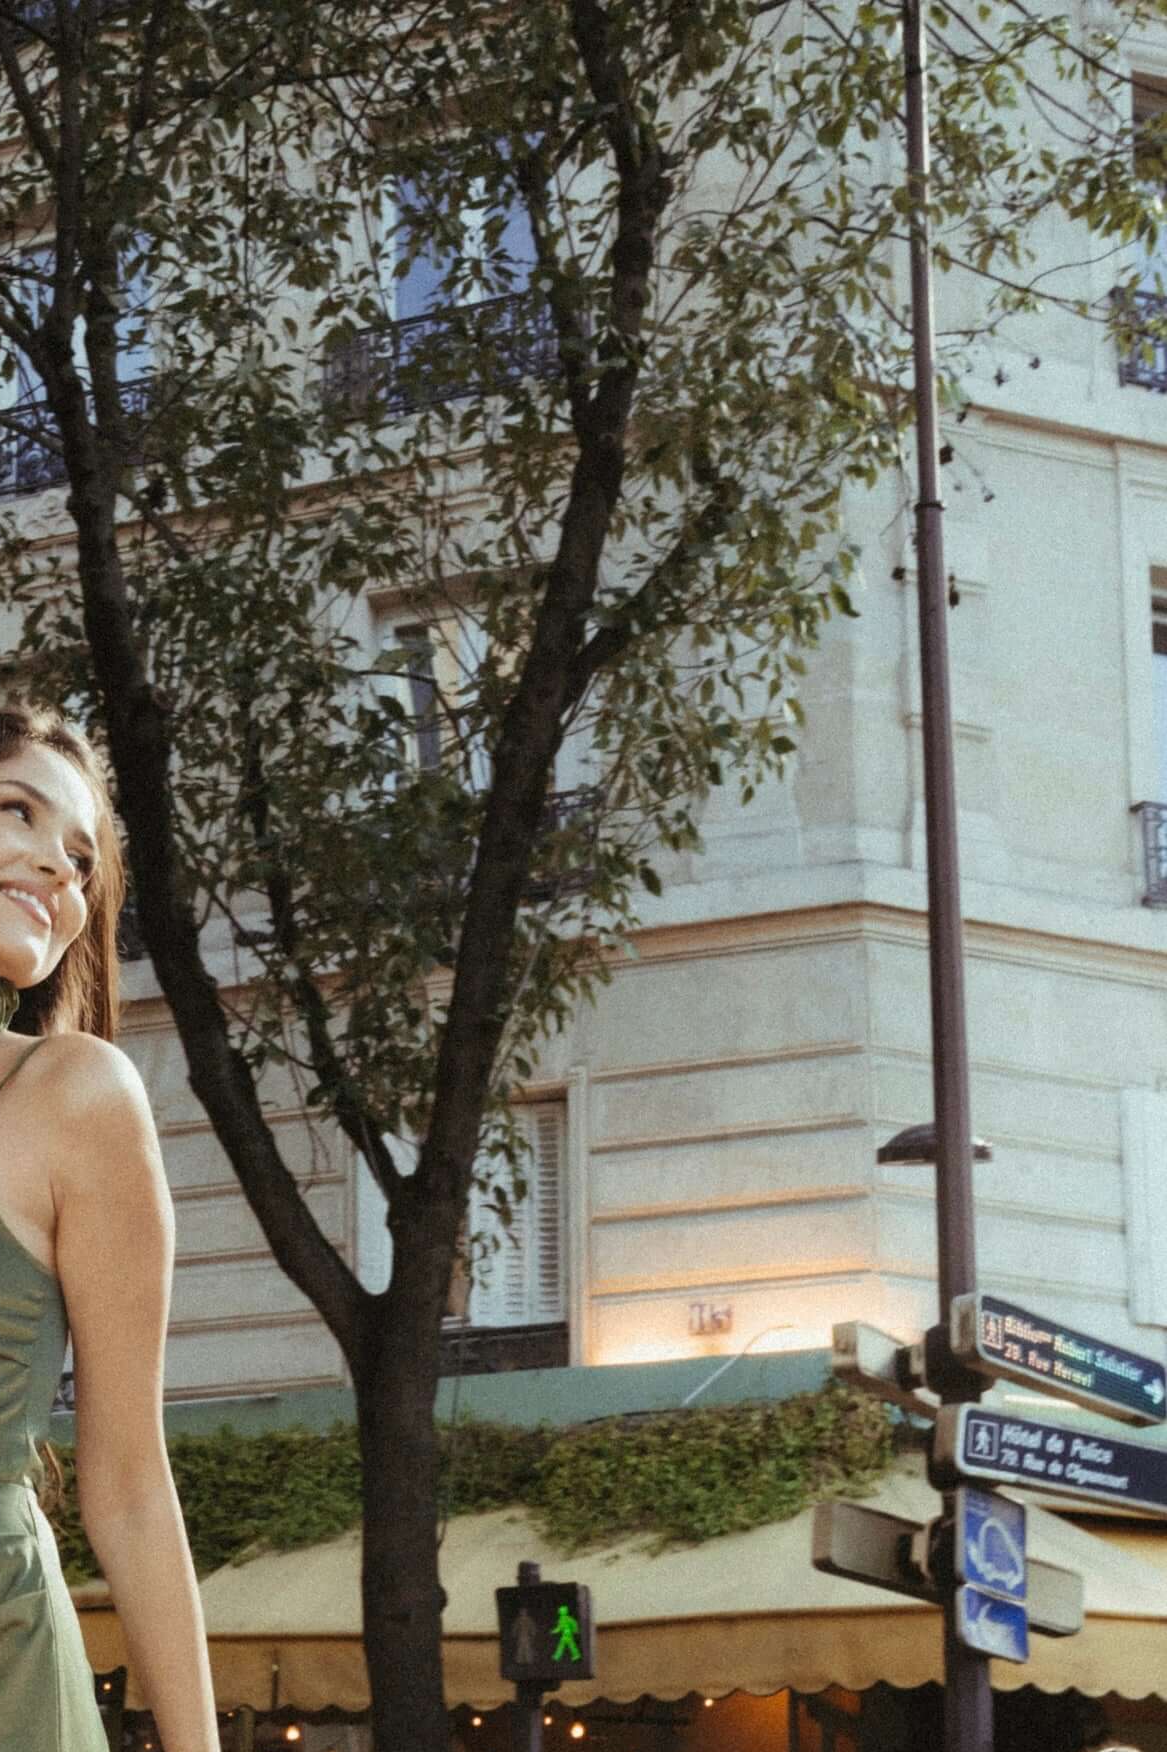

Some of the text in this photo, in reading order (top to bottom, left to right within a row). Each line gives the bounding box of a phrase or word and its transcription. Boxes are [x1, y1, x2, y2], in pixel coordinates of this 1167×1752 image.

[1027, 1350, 1050, 1372] Rue
[1001, 1423, 1113, 1464] Hôtel de Police
[1022, 1453, 1046, 1472] Rue
[1047, 1460, 1064, 1476] de
